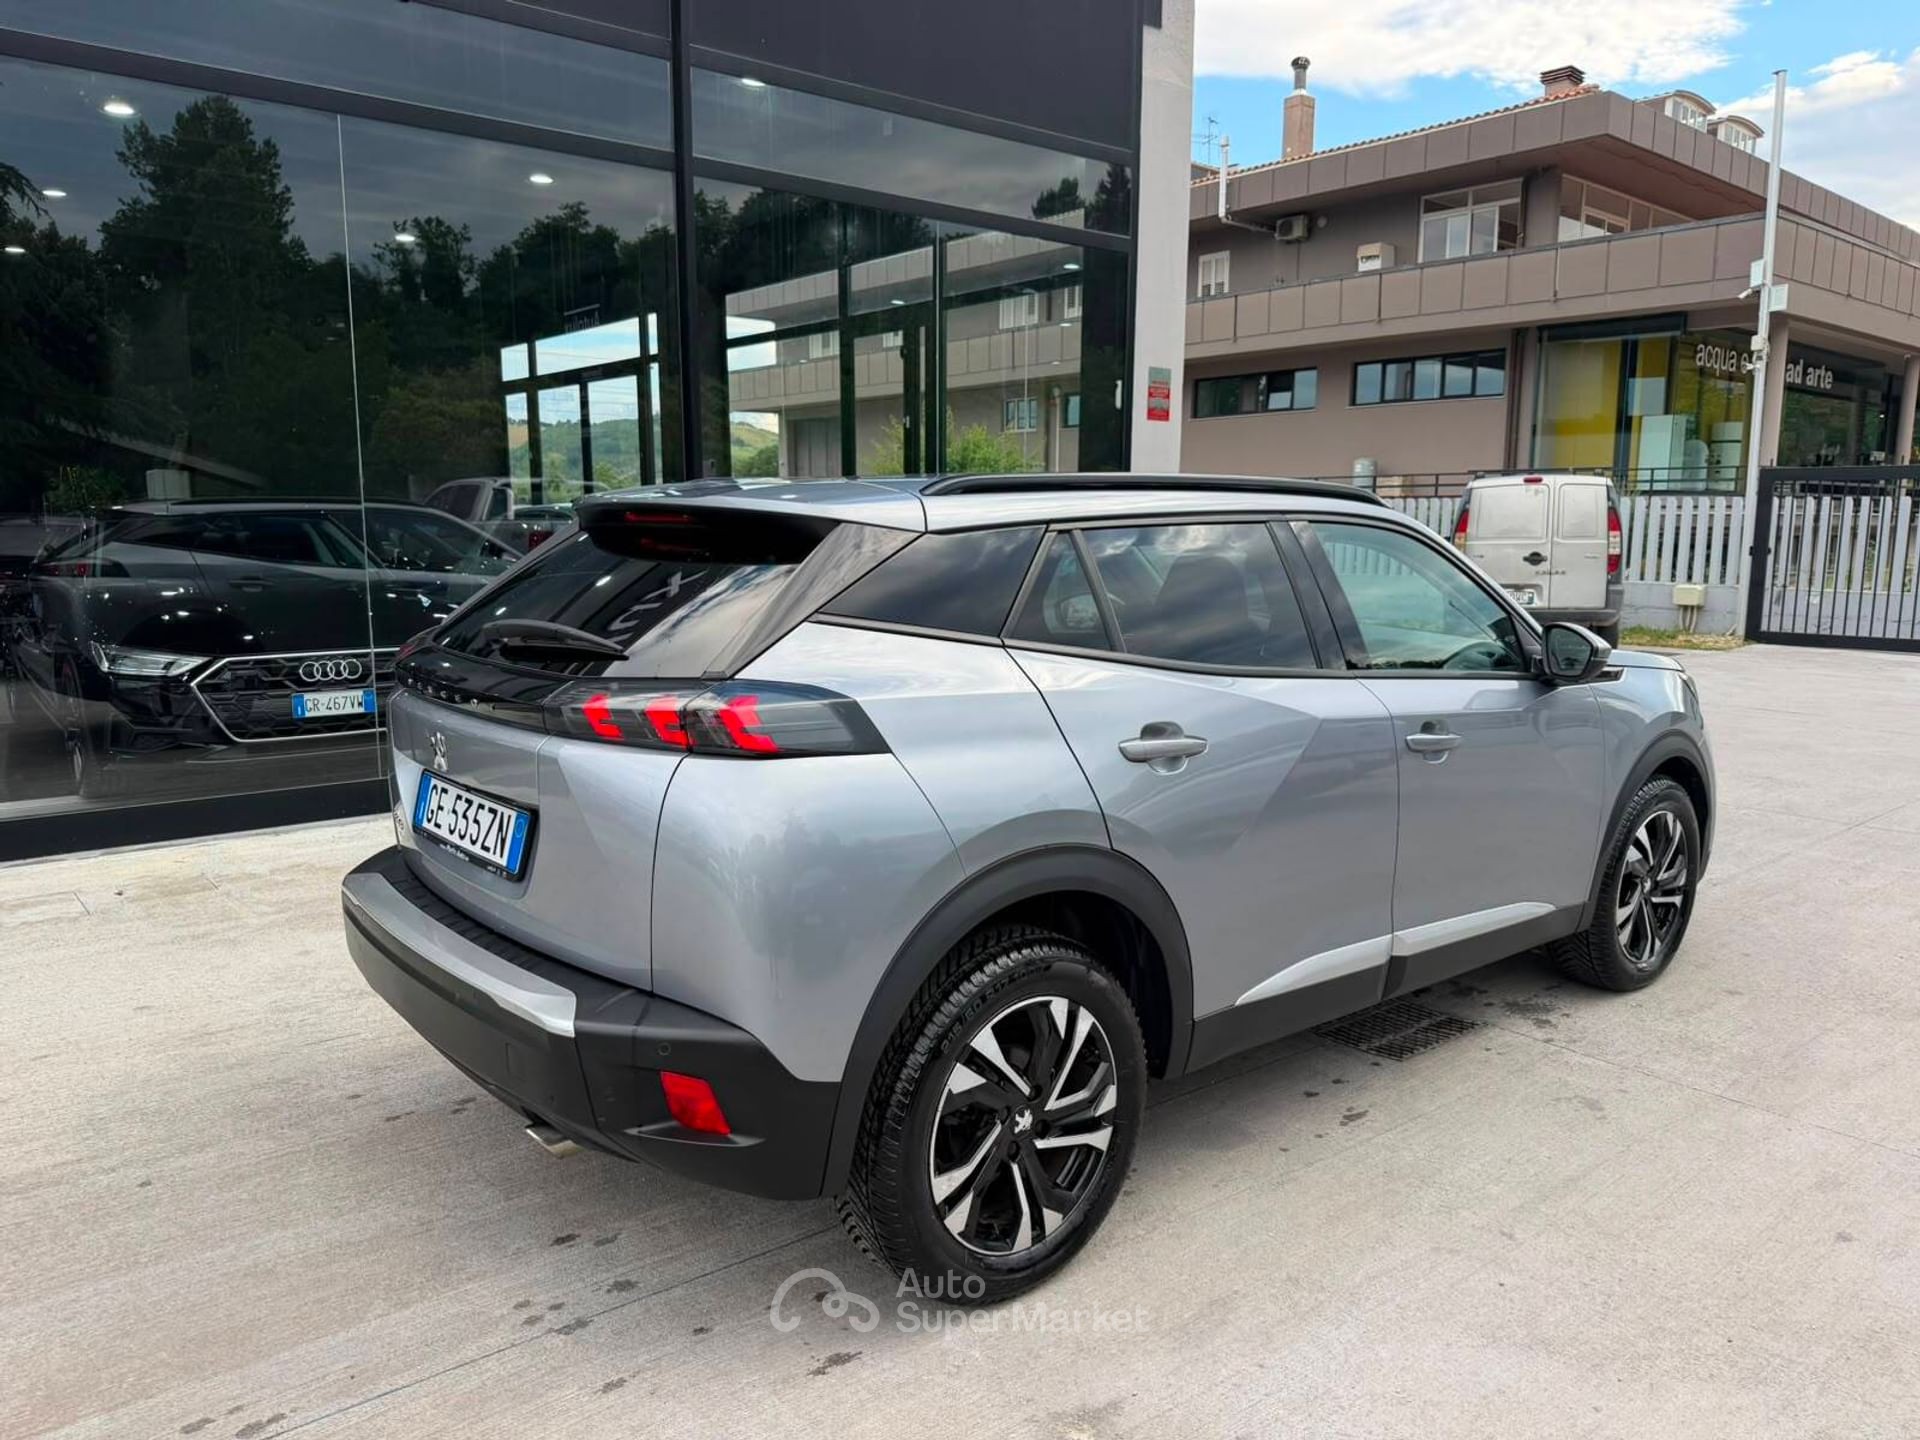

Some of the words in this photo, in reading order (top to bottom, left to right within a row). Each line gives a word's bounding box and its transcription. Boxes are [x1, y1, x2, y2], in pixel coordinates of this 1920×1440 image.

[1696, 343, 1737, 377] acqua
[1786, 359, 1804, 385] ad
[1806, 365, 1833, 389] arte
